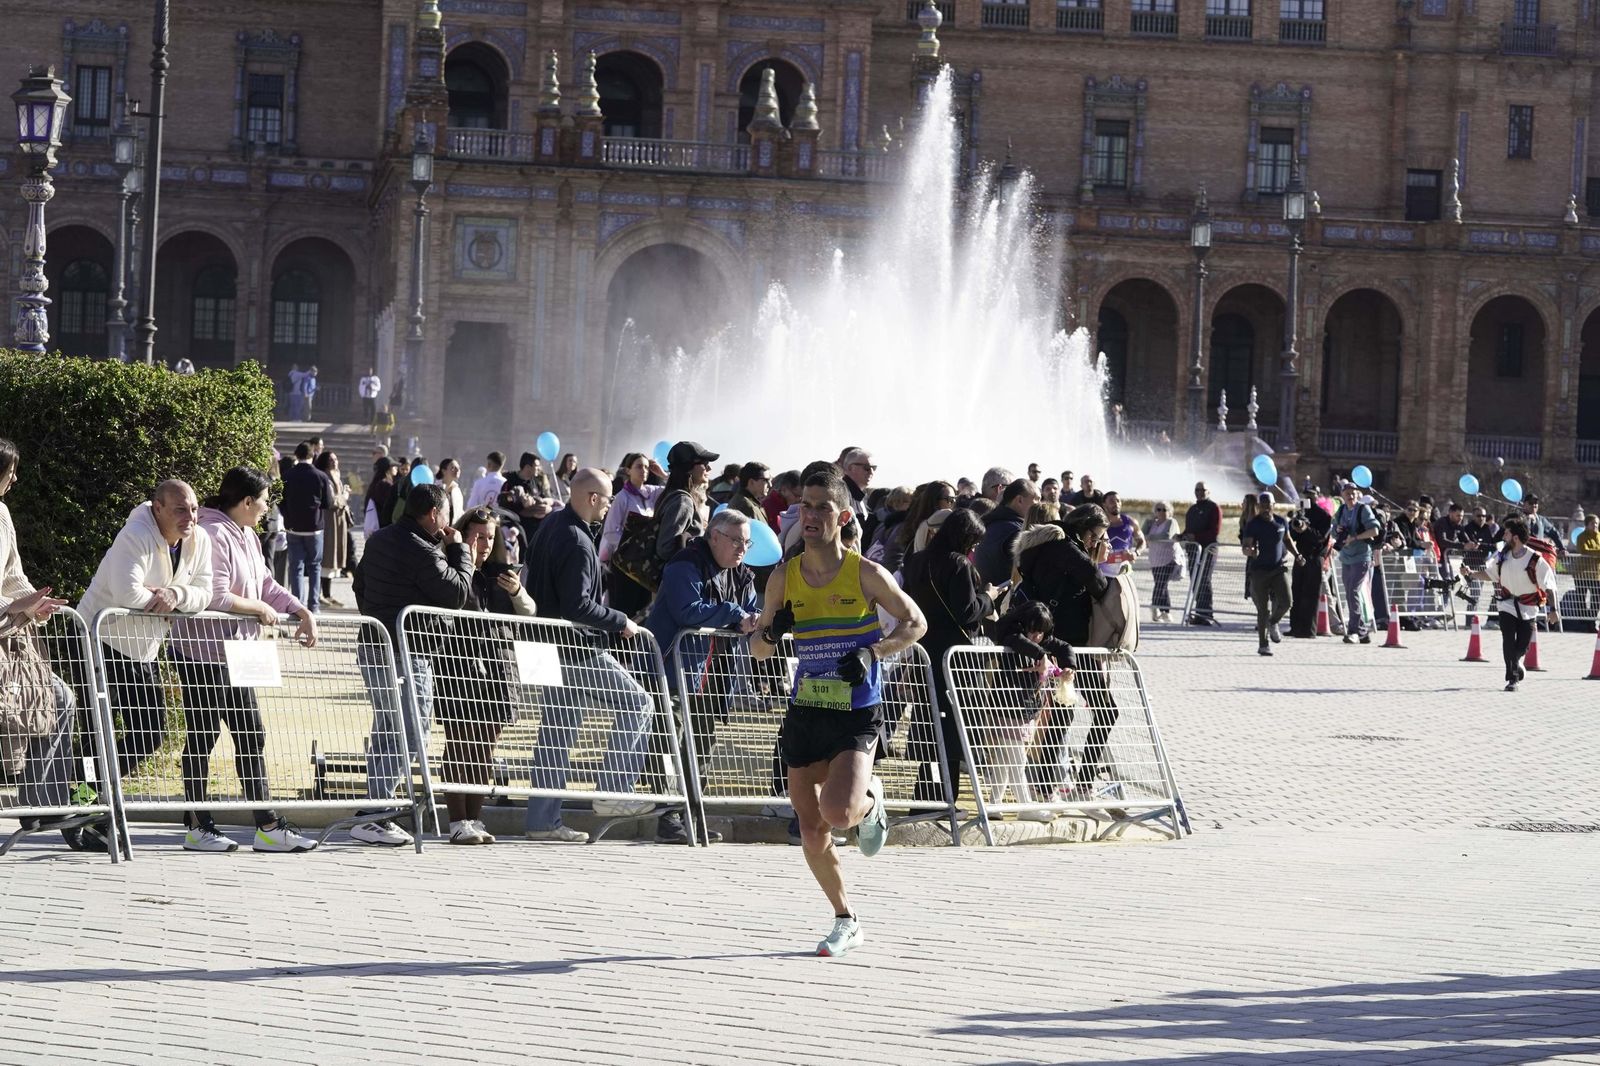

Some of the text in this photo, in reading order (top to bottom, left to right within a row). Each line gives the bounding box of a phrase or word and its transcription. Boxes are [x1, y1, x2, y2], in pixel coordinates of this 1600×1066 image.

[814, 641, 857, 651] DESPORTIVO
[812, 685, 829, 693] 3101
[827, 701, 851, 710] DIOGO
